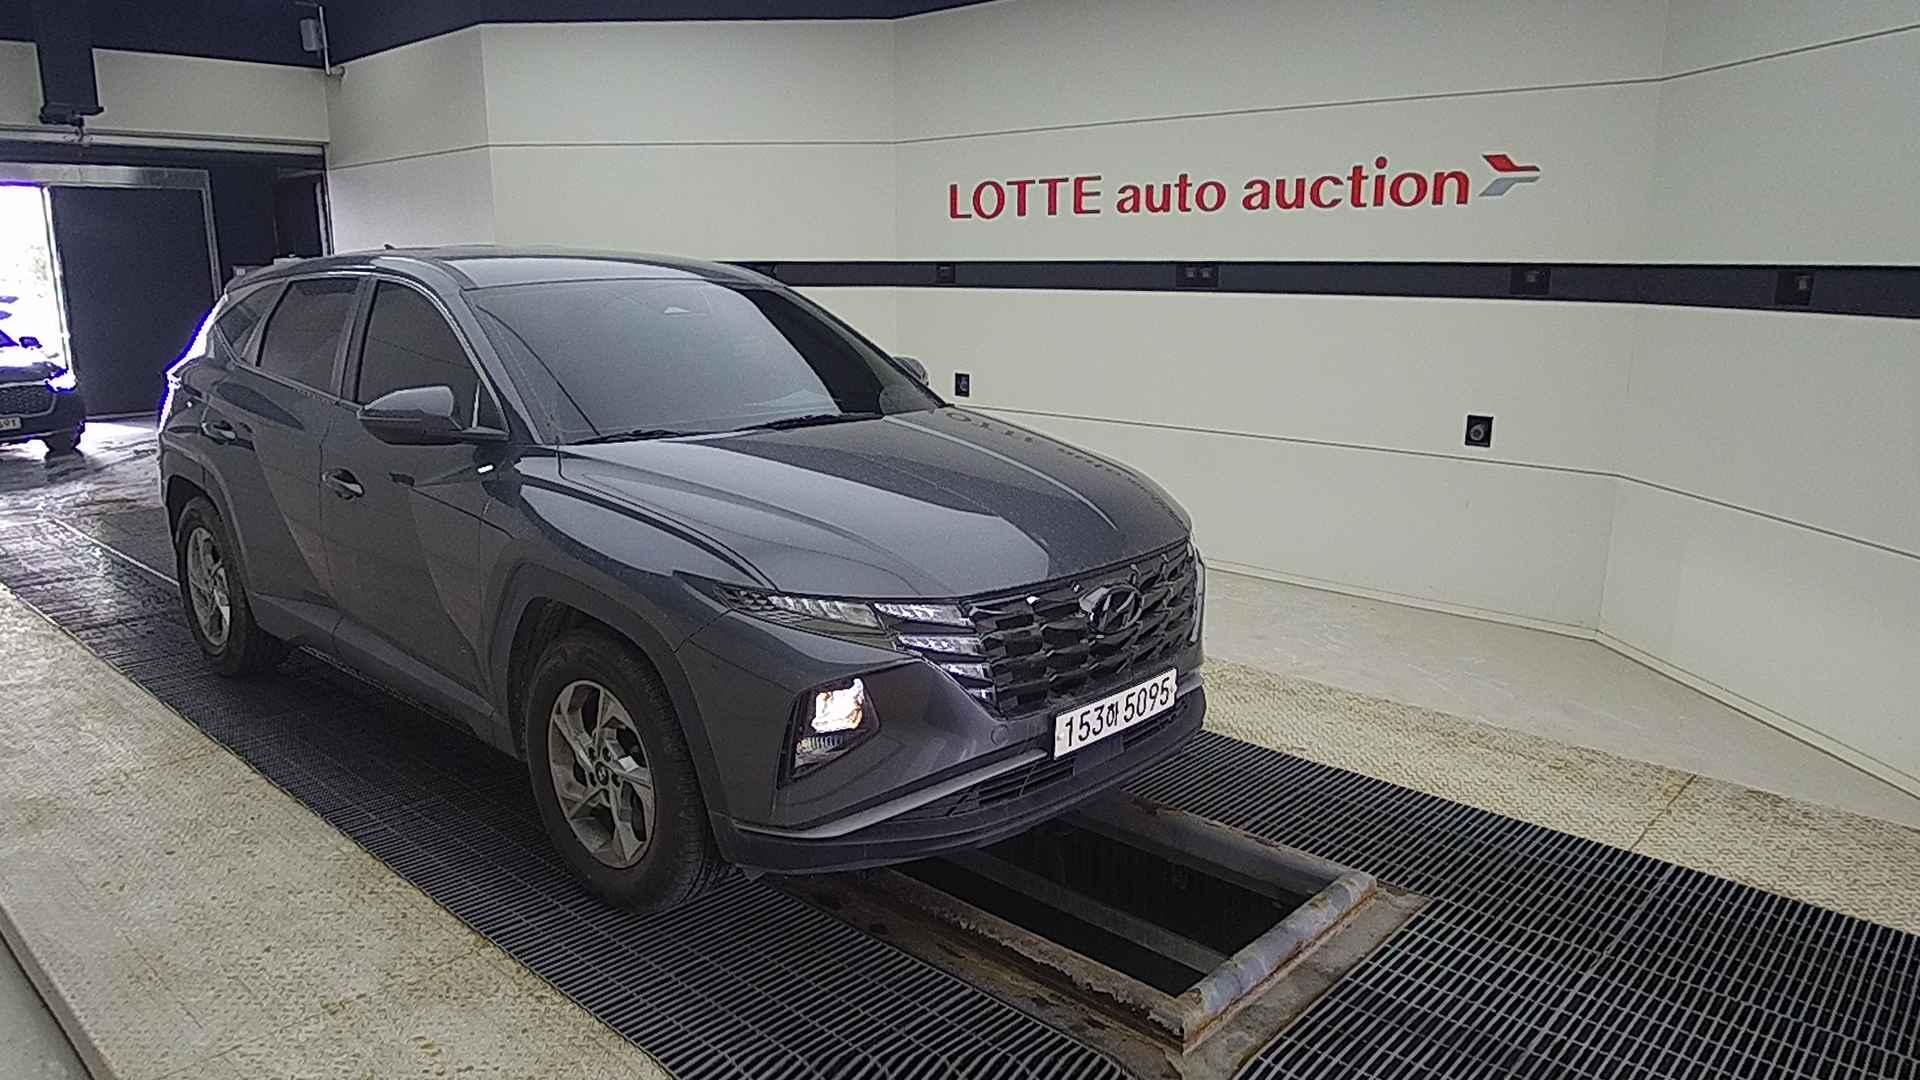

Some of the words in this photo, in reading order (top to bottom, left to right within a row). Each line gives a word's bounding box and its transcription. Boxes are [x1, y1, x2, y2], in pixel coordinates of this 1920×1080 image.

[949, 175, 1102, 220] LOTTE
[1116, 173, 1227, 214] auto
[1242, 156, 1470, 210] auction
[1124, 677, 1170, 723] 5095
